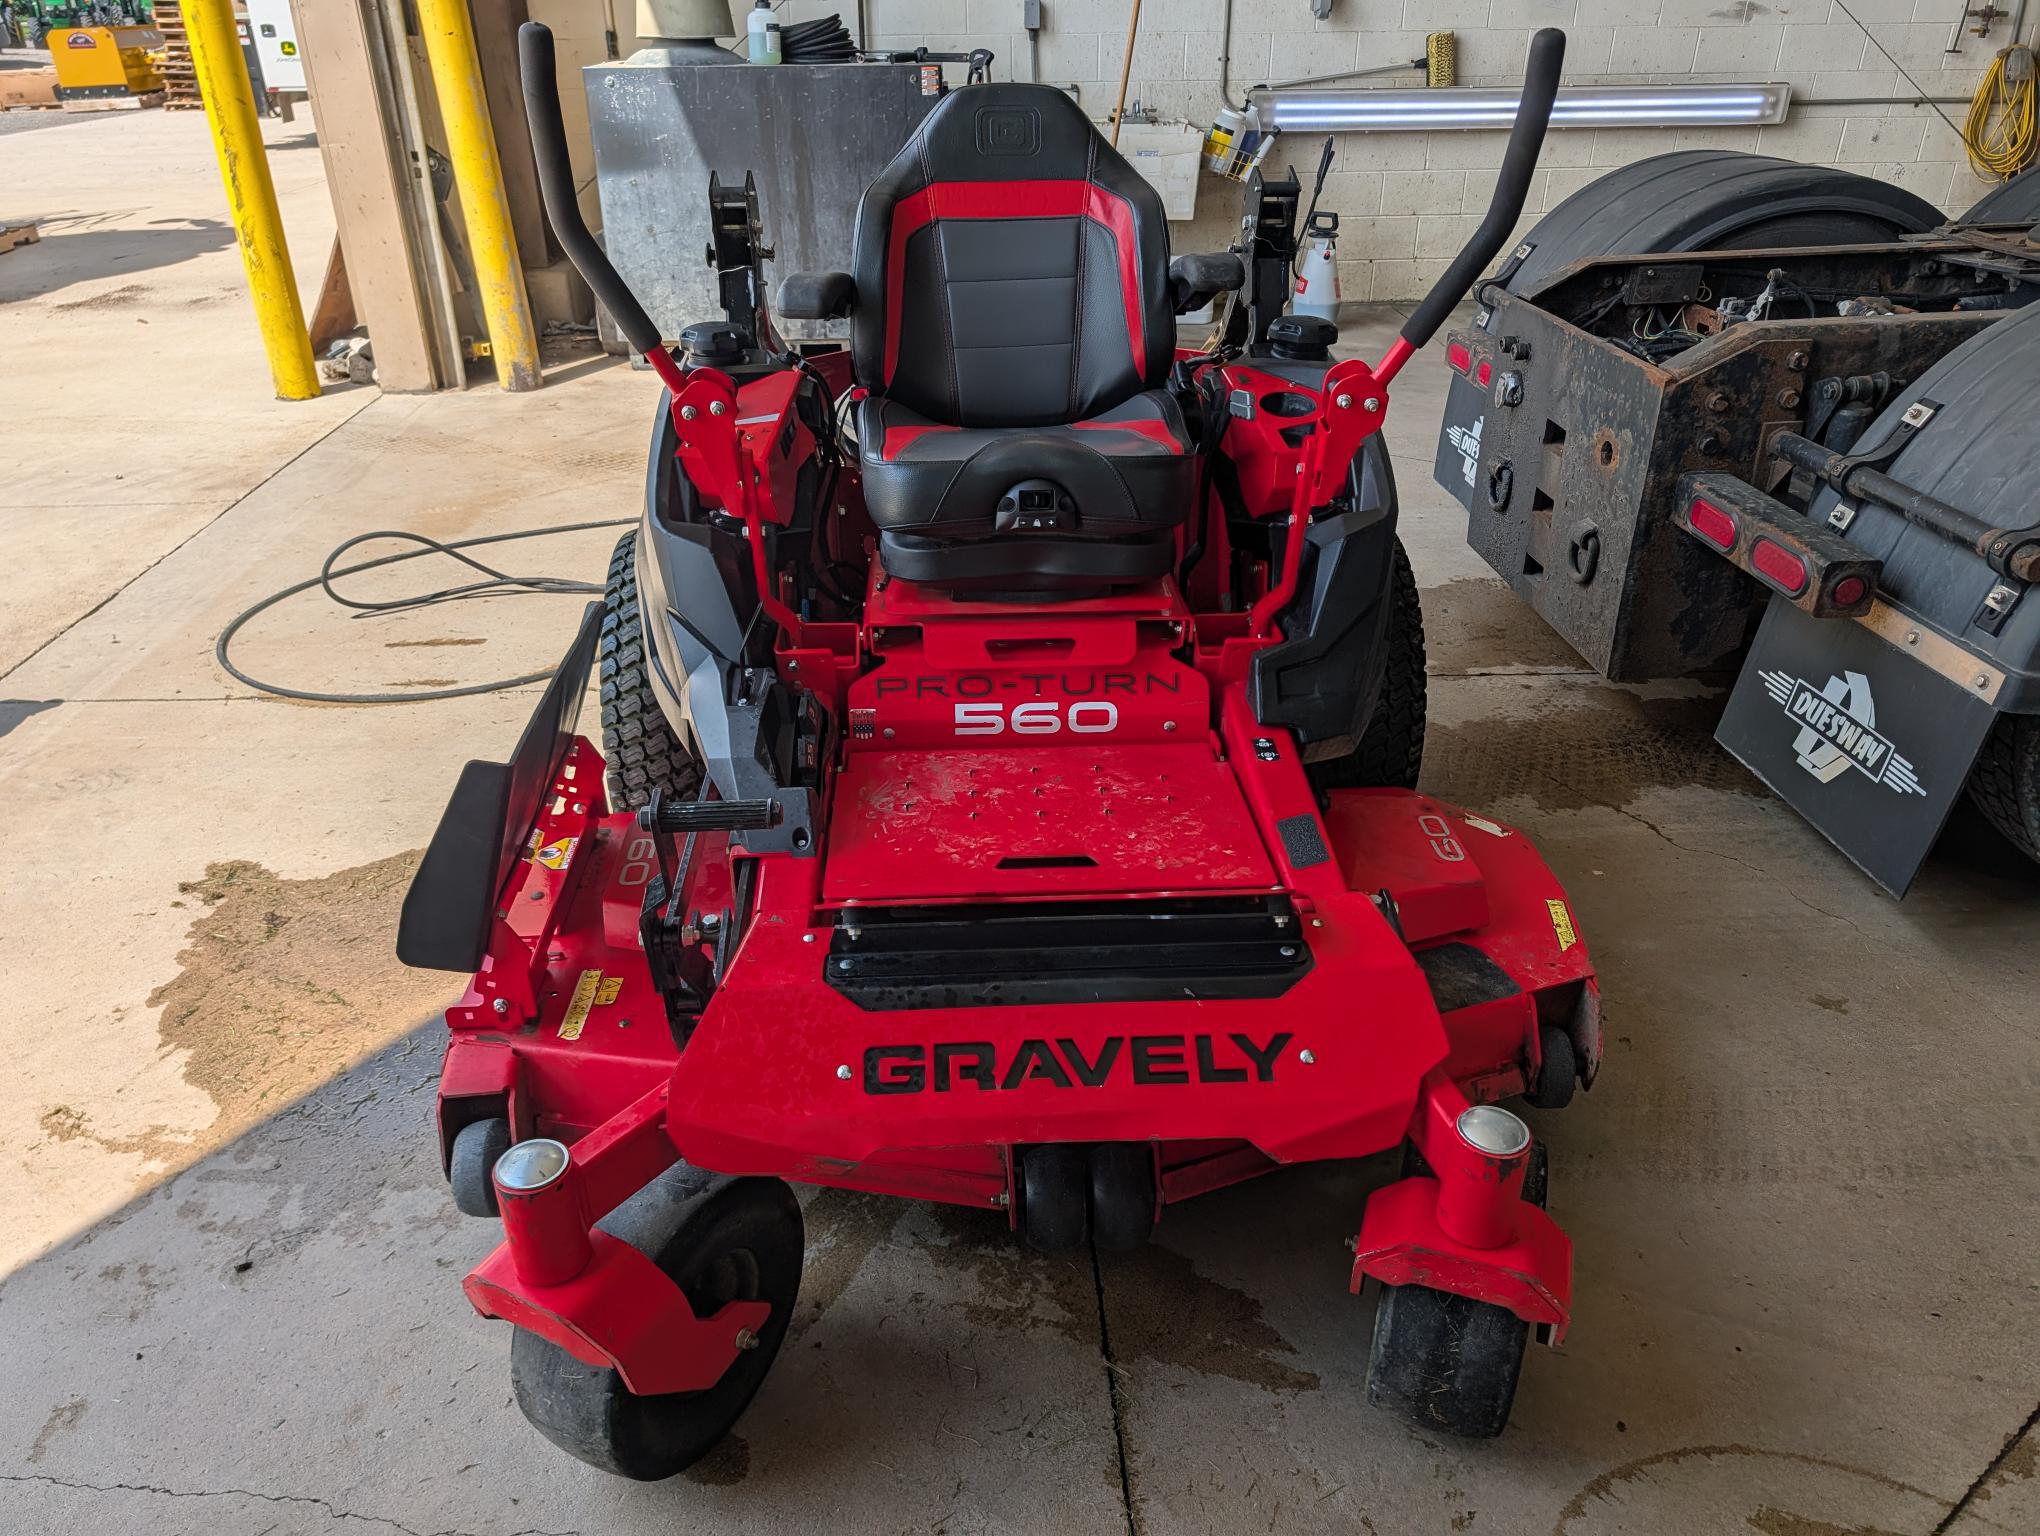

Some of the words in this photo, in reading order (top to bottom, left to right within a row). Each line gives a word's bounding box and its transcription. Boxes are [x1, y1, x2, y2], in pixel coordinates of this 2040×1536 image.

[876, 672, 1180, 699] PRO-TURN
[954, 701, 1118, 736] 560
[1793, 690, 1886, 768] DUESWAY
[618, 838, 657, 886] 60
[1417, 815, 1465, 862] 60
[863, 1032, 1295, 1096] GRAVELY
